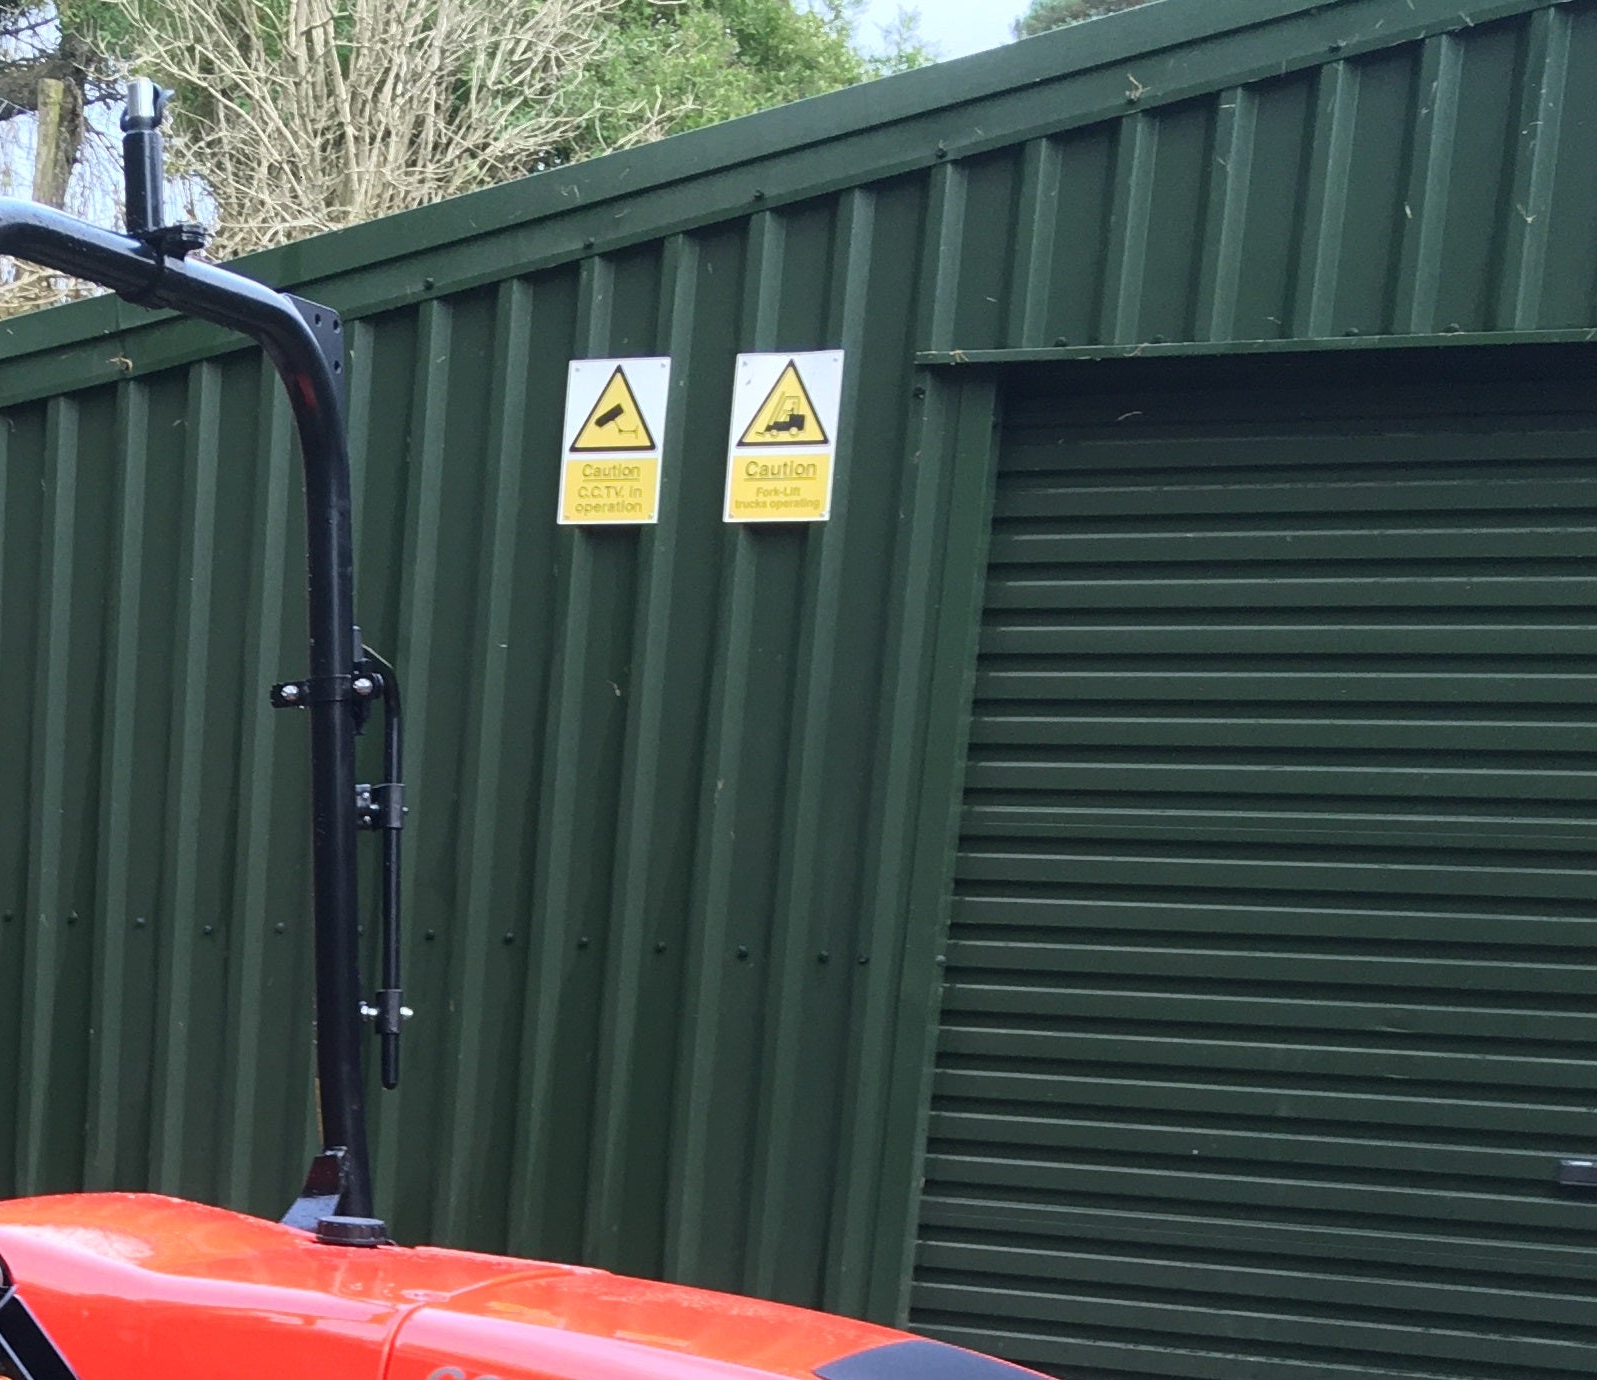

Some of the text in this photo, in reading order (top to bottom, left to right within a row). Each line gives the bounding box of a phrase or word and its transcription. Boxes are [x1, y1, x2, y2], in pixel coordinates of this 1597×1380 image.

[581, 463, 641, 478] Caution
[745, 460, 817, 477] Caution
[628, 486, 643, 499] in
[575, 501, 643, 516] operation
[735, 499, 821, 511] trucks operating
